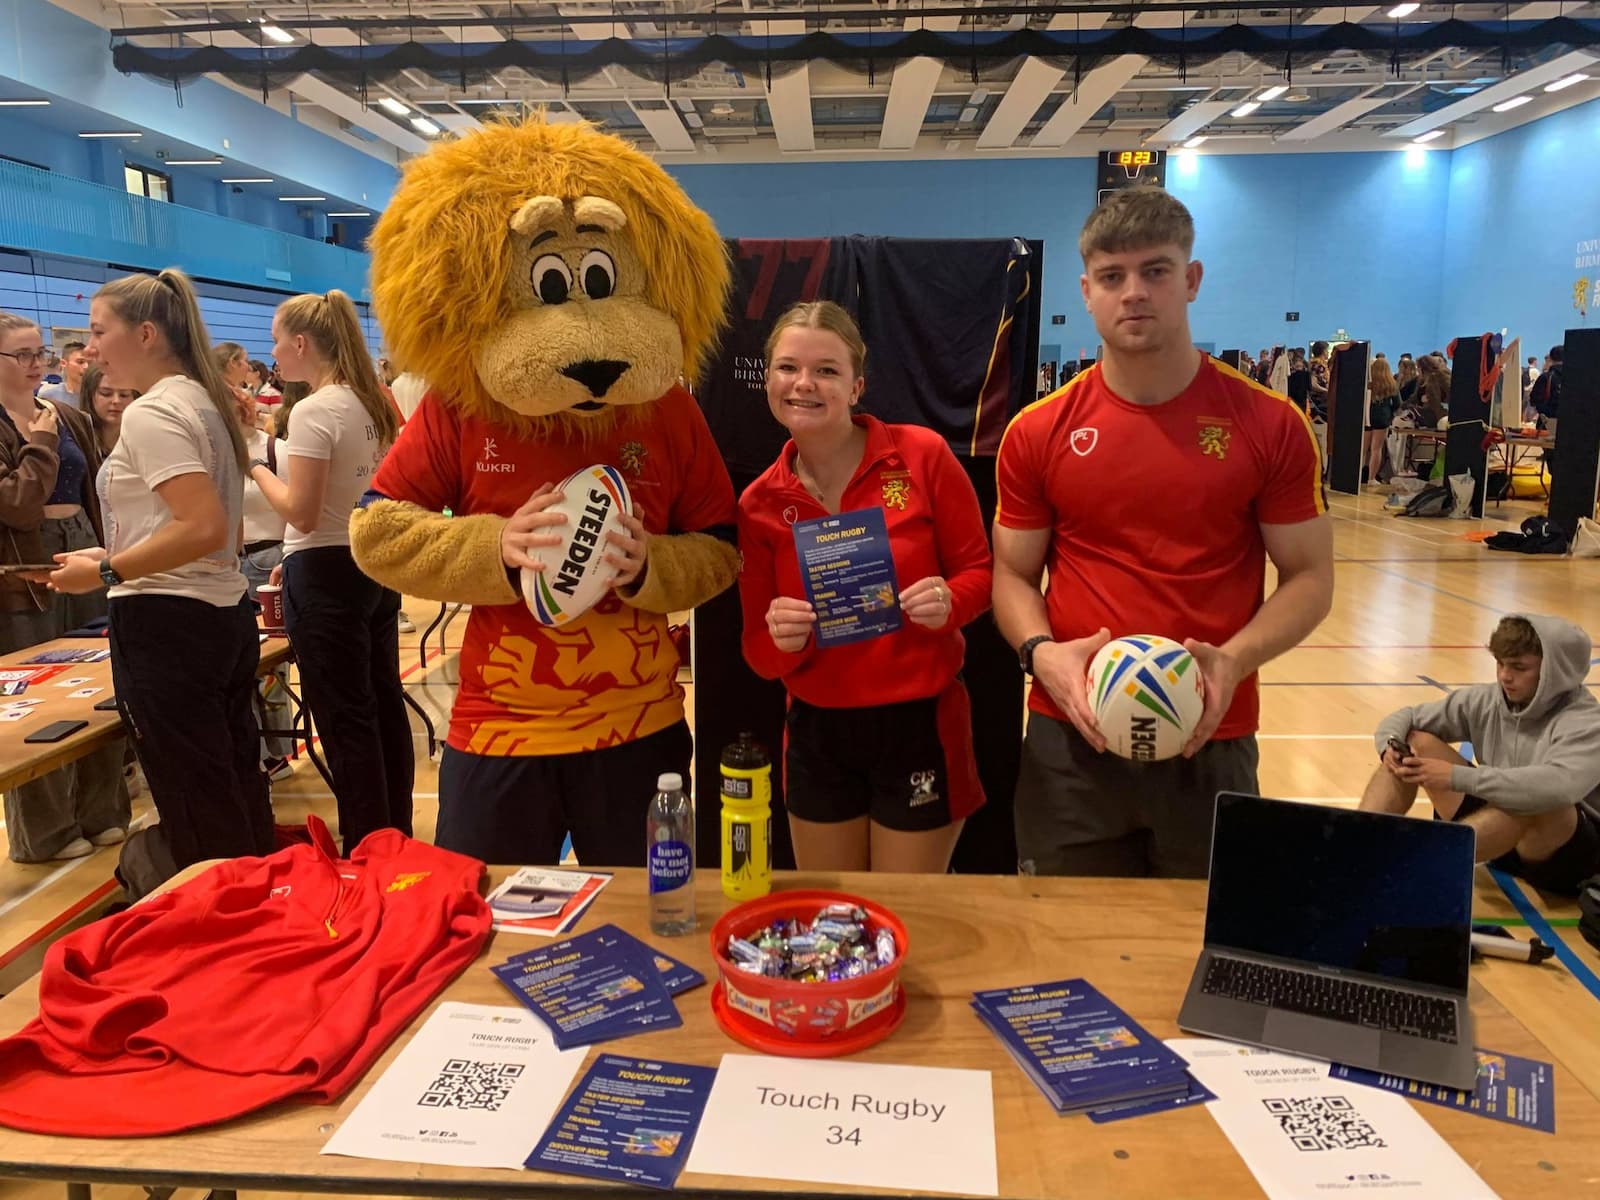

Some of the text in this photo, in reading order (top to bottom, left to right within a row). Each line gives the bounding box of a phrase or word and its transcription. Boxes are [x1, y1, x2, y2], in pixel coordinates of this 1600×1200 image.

[738, 238, 832, 320] 77
[476, 461, 516, 473] KUKRI
[552, 489, 611, 596] STEEDEN
[816, 526, 866, 544] TOUCH RUGBY
[657, 846, 683, 857] have
[652, 856, 688, 868] we met
[652, 866, 689, 878] before?
[523, 952, 581, 974] TOUCH RUGBY
[1008, 989, 1071, 1004] TOUCH RUGBY
[471, 1032, 538, 1045] TOUCH RUGBY
[618, 1070, 690, 1086] TOUCH RUGBY
[1244, 1069, 1279, 1077] TOUCH
[757, 1086, 946, 1123] Touch Rugby
[826, 1125, 862, 1147] 34
